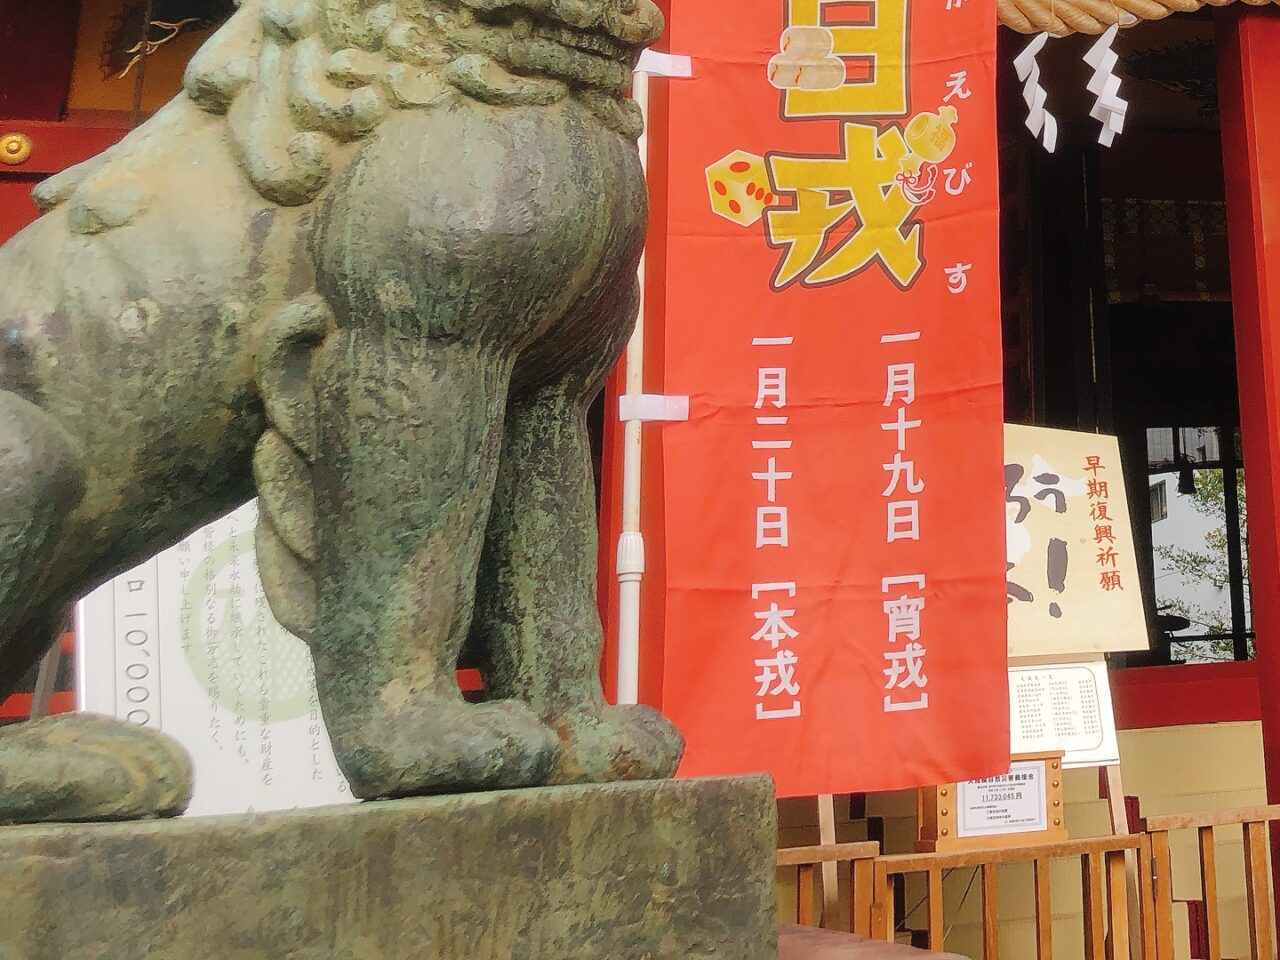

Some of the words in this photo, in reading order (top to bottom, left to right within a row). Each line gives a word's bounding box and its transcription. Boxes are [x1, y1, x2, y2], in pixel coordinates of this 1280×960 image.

[1083, 455, 1124, 592] 早期復興祈願
